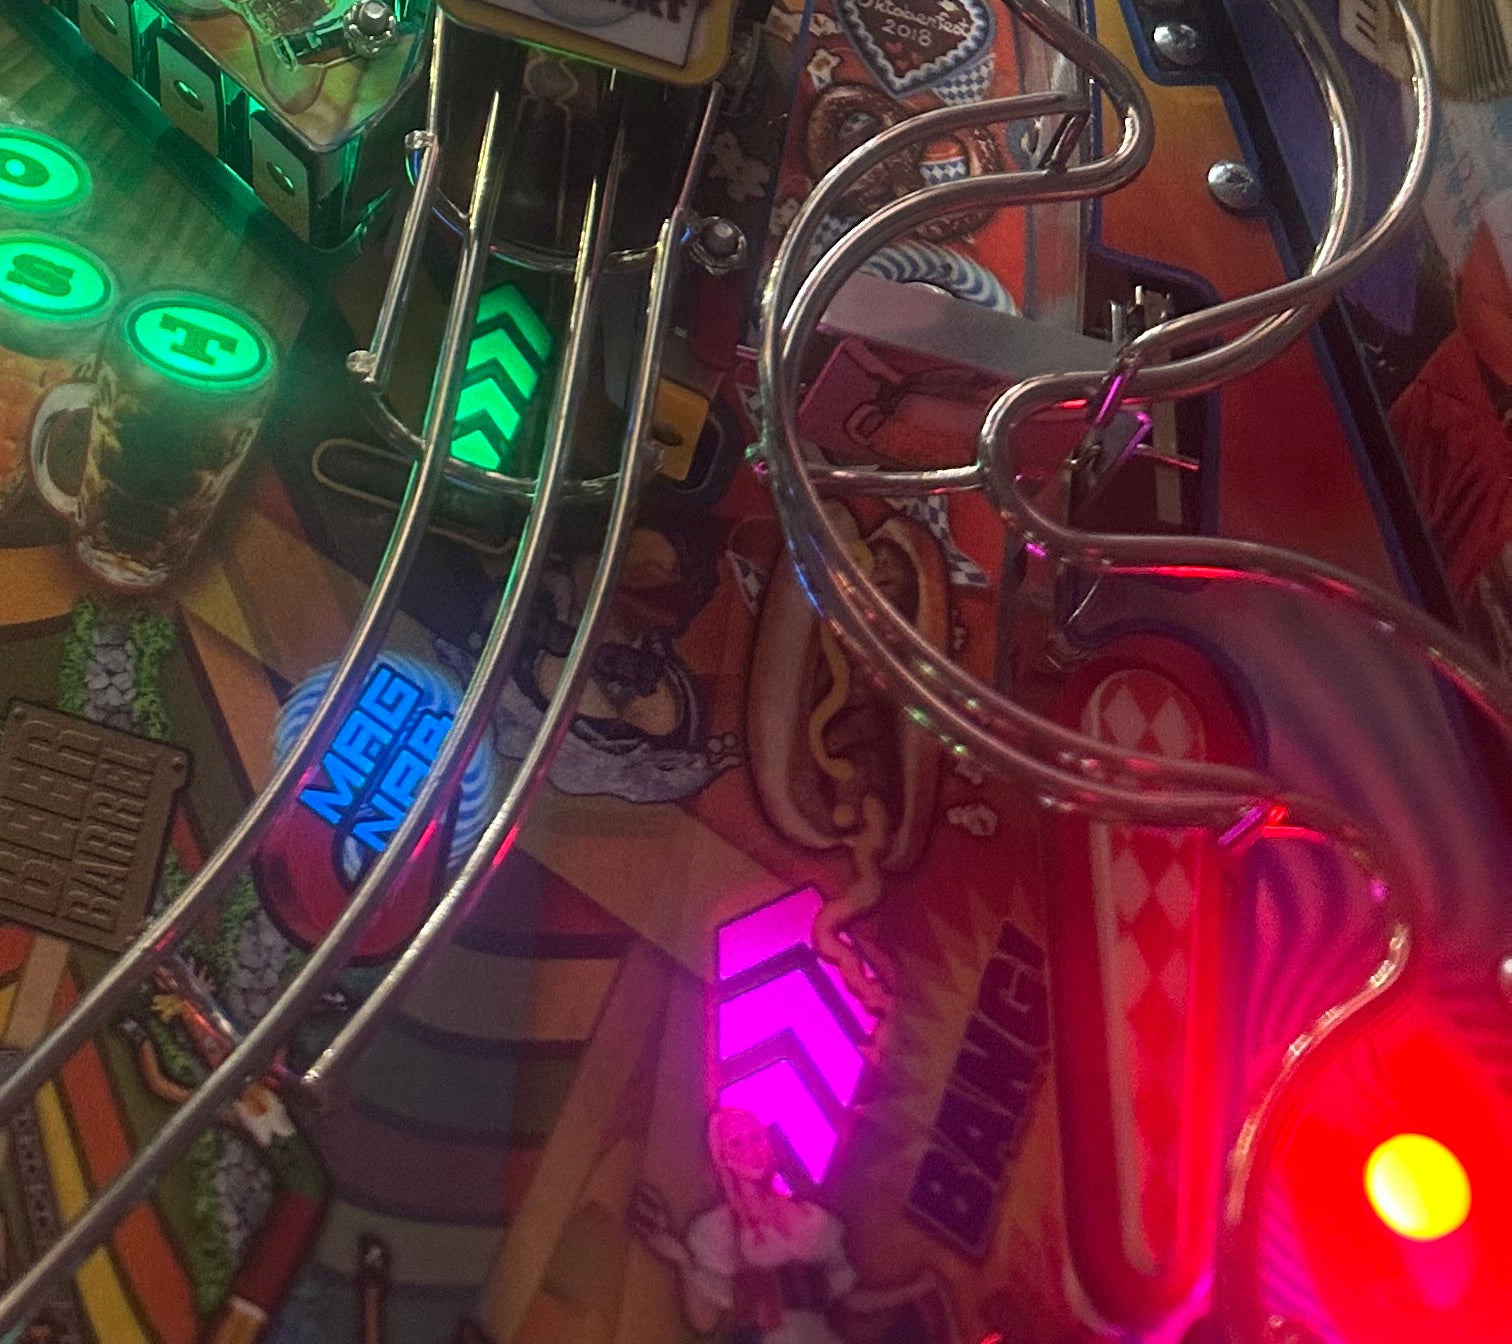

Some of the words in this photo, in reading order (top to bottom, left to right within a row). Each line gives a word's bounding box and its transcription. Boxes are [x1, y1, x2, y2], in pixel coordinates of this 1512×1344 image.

[881, 19, 932, 47] 2018
[6, 253, 74, 297] S
[159, 313, 238, 366] T
[297, 663, 424, 825] MAG
[64, 746, 157, 934] BARREL
